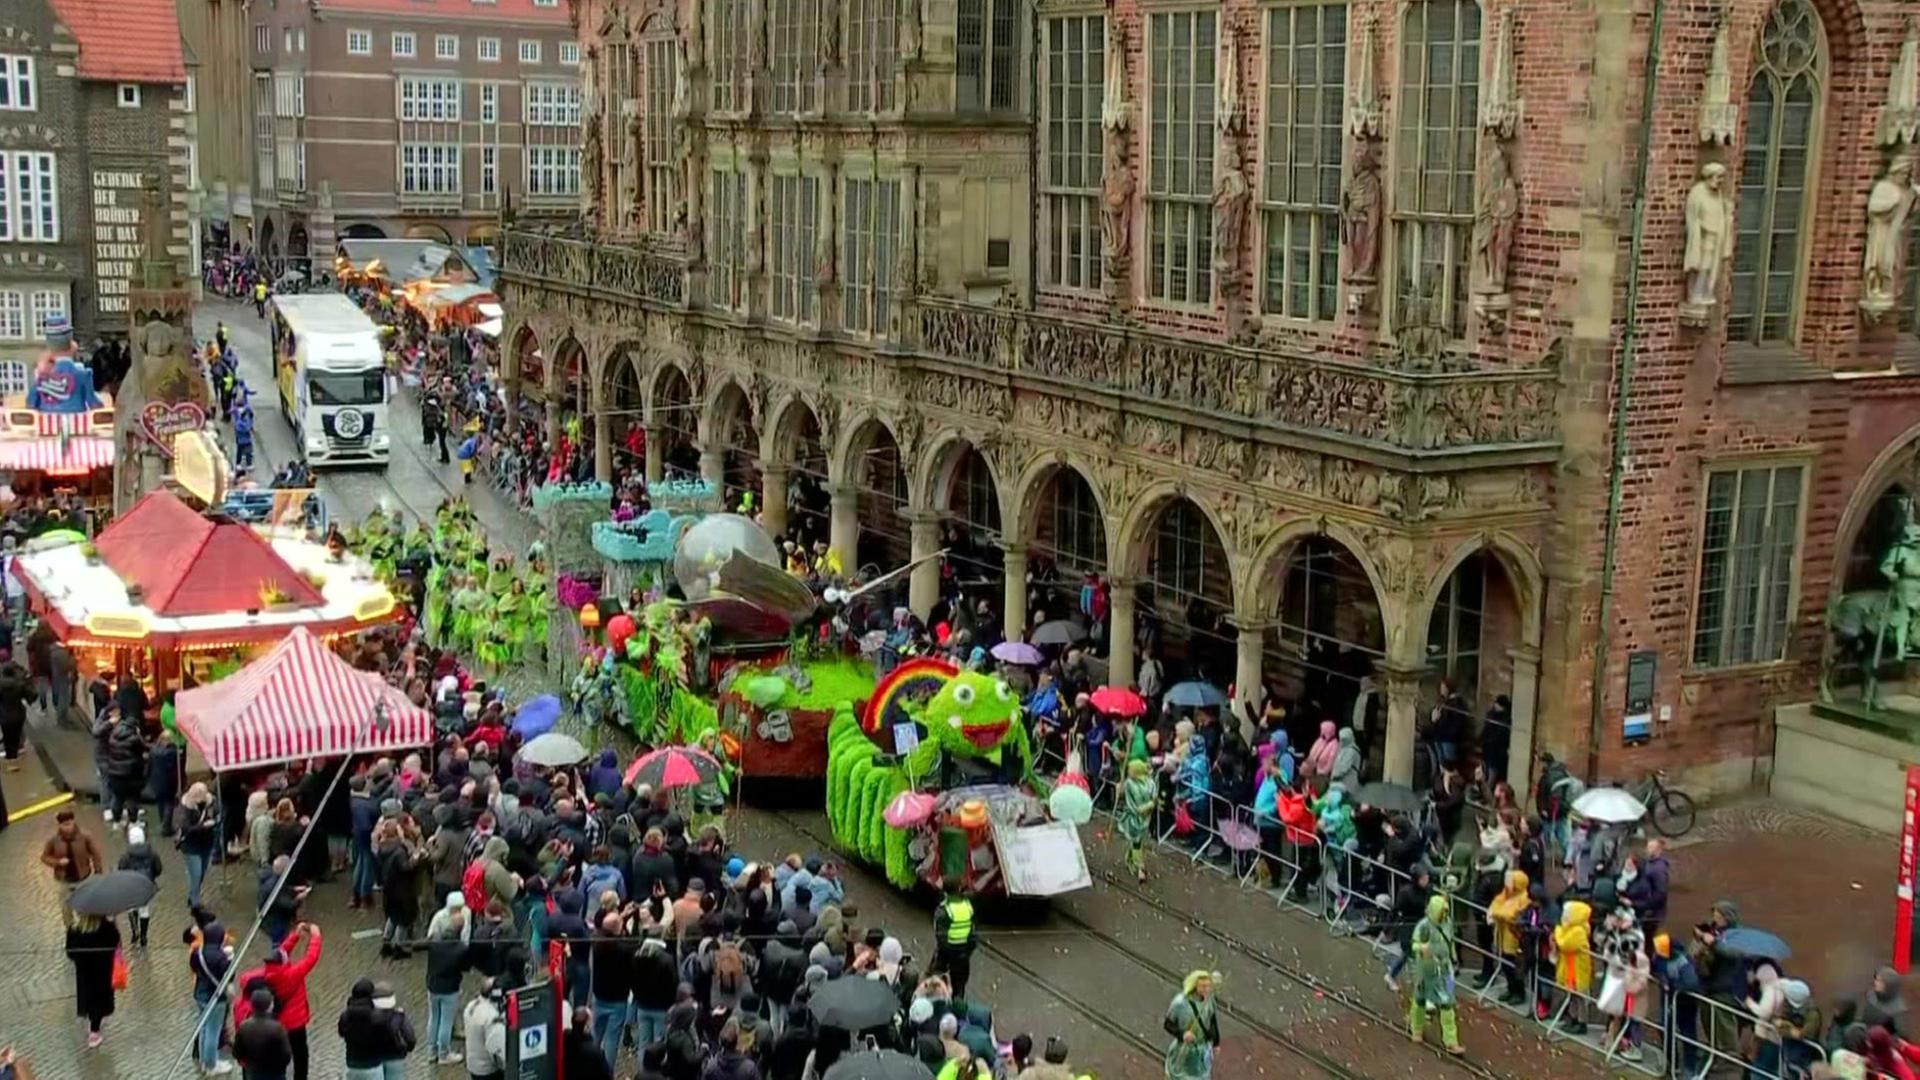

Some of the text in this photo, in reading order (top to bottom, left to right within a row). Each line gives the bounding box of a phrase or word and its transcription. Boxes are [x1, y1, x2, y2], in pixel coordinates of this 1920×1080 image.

[93, 171, 143, 188] GEDENKE
[94, 189, 116, 205] DER
[96, 225, 137, 242] DIE DAS
[97, 260, 134, 277] UNSER
